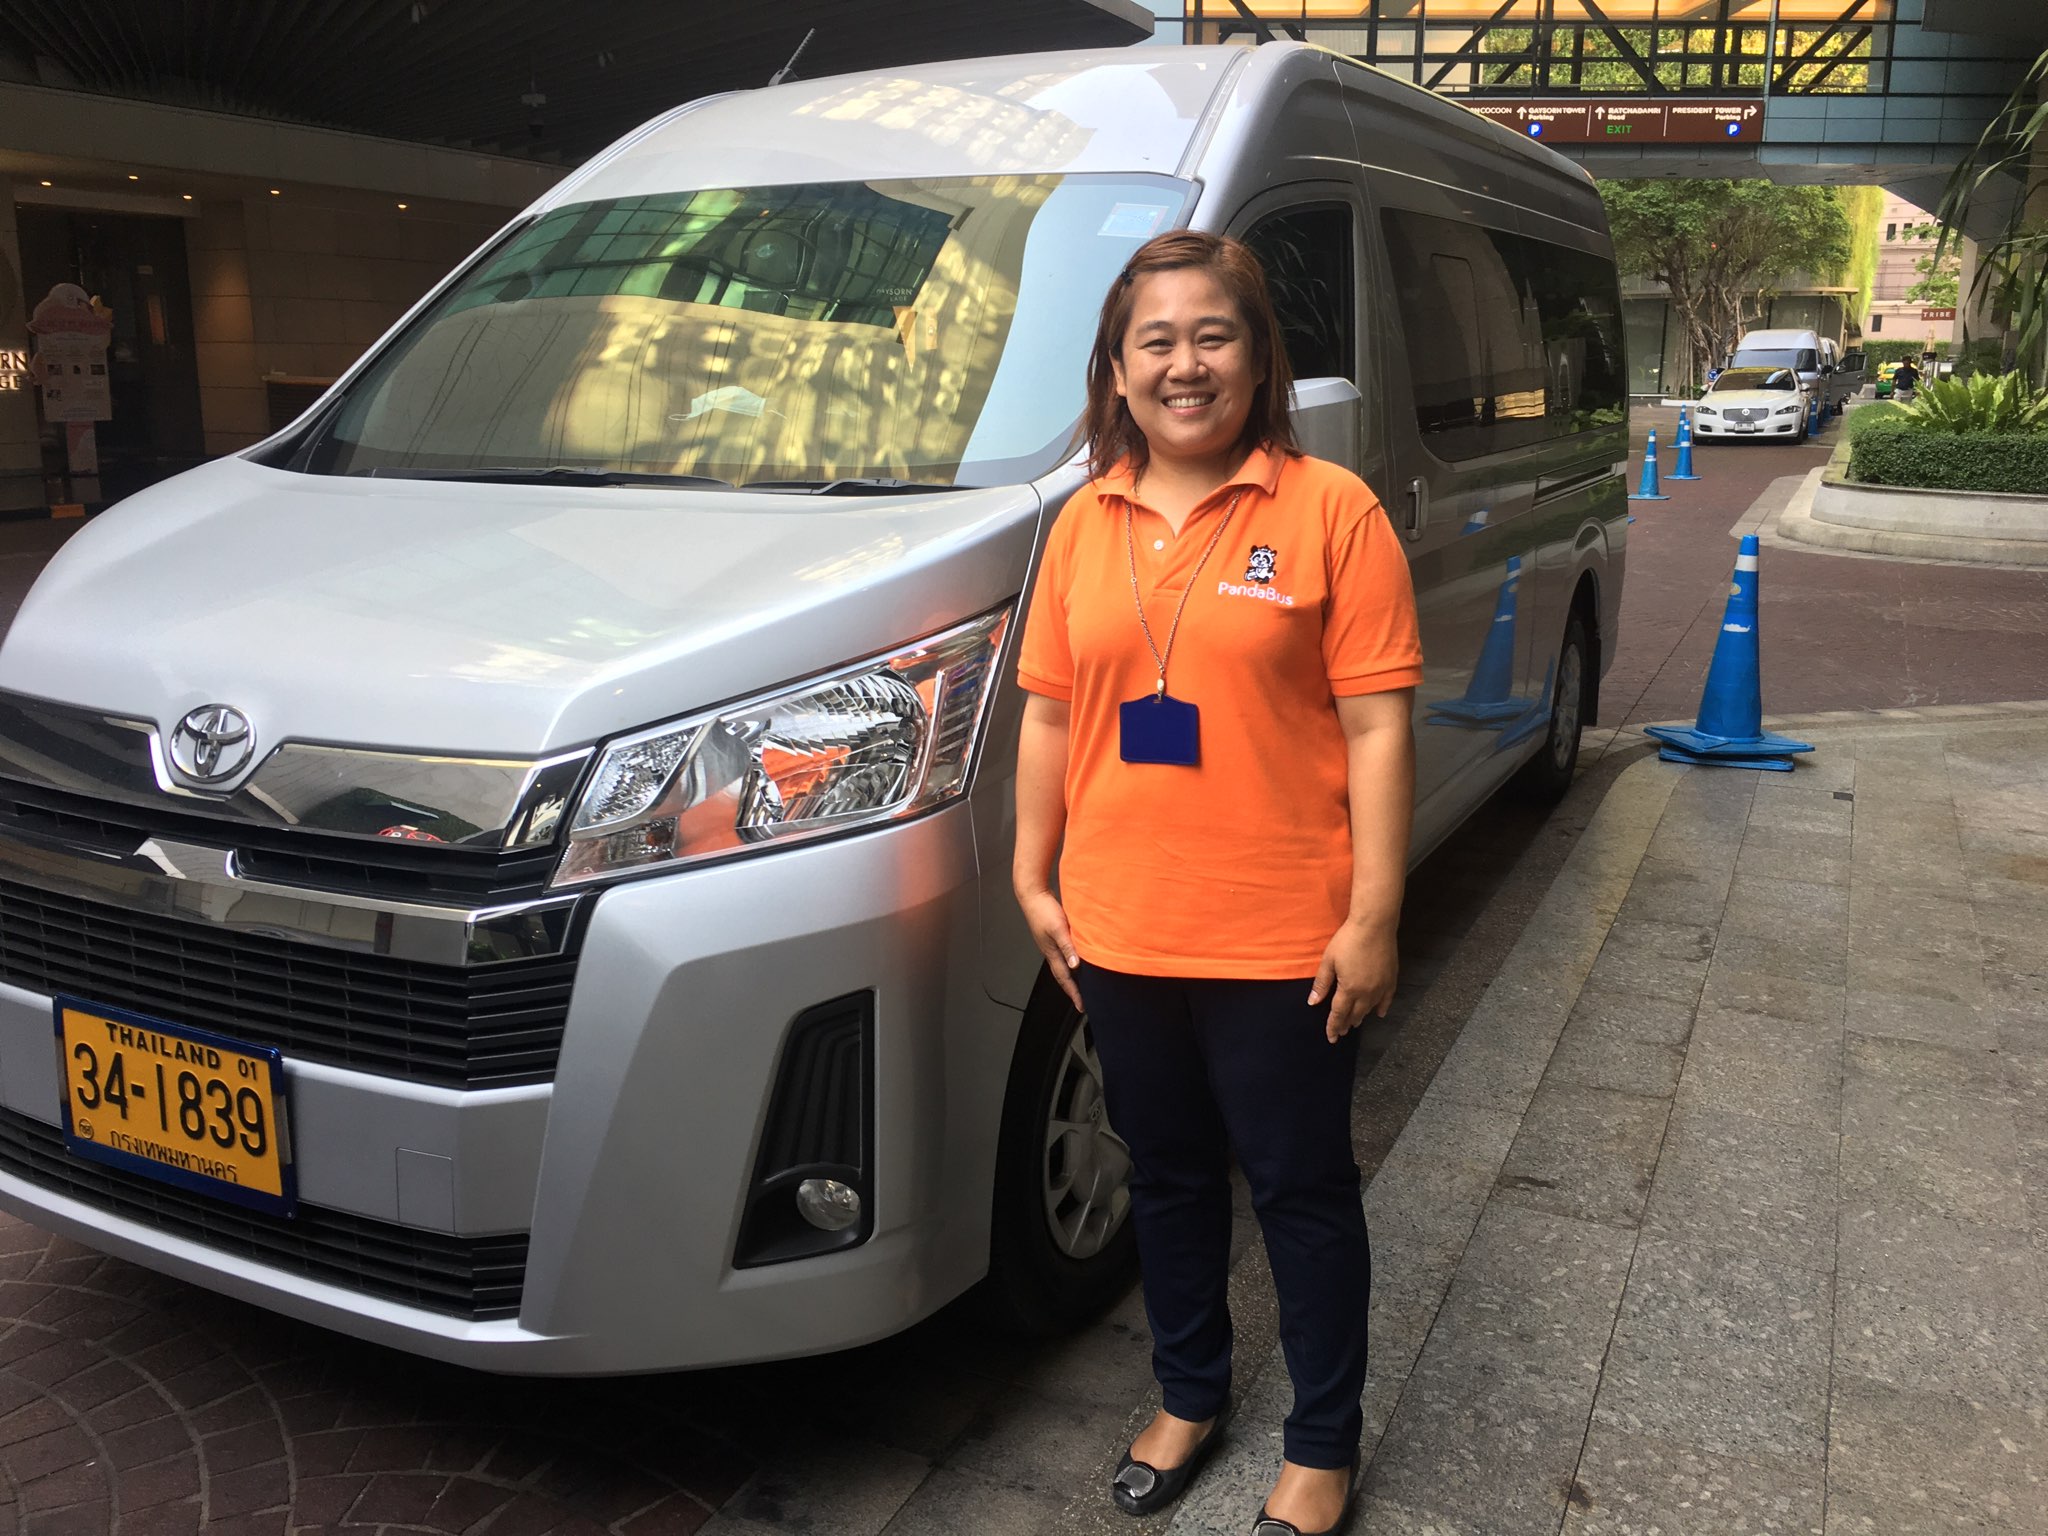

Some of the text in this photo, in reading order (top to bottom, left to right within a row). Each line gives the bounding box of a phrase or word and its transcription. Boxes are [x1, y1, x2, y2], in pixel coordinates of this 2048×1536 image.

[1530, 124, 1540, 135] P
[1606, 125, 1632, 134] EXIT
[1728, 124, 1738, 135] P
[0, 352, 28, 370] RN
[1218, 582, 1293, 605] PandaBus
[105, 1022, 257, 1081] THAILAND 01
[74, 1043, 267, 1157] 34-1839
[110, 1130, 238, 1183] กรงเทพมหานคร
